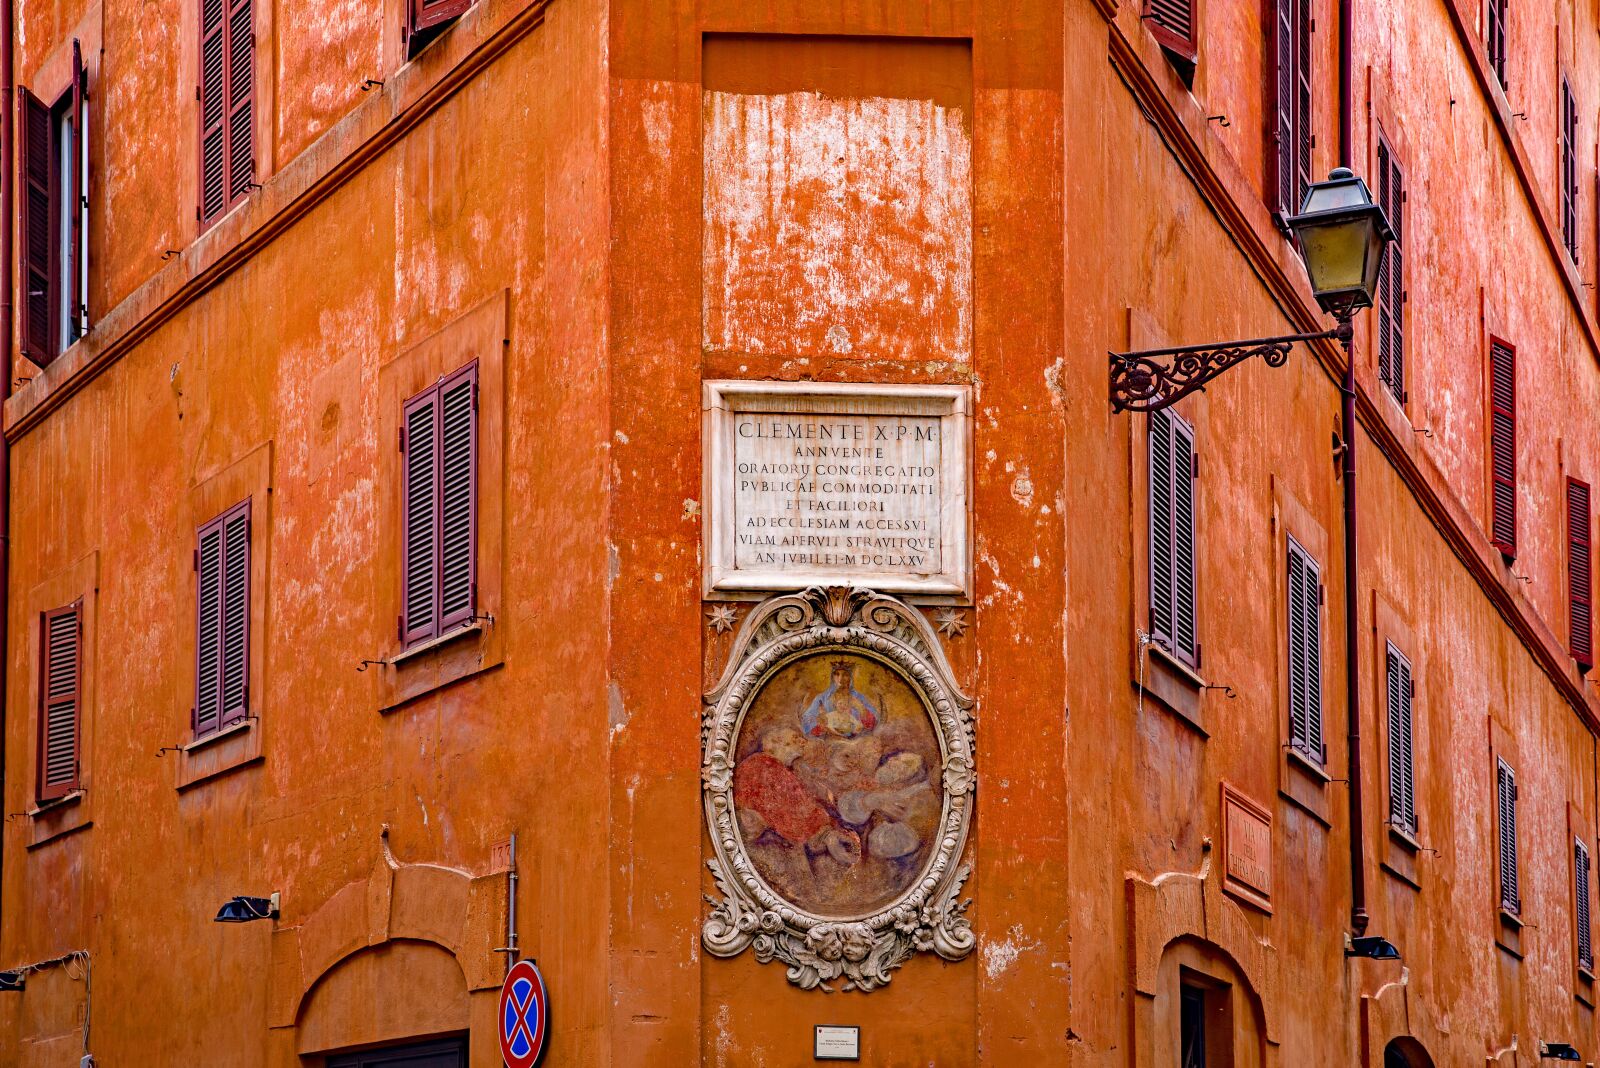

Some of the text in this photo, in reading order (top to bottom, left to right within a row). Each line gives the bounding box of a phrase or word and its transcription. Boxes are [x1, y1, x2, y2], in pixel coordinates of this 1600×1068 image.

[738, 422, 864, 440] CLEMENTE
[795, 446, 884, 459] ANNVENTE
[815, 464, 935, 478] CONGREGATIO
[741, 480, 933, 495] PVBLICAE COMMODITATI
[786, 499, 885, 512] ET FACILIORI
[770, 517, 850, 529] ECCLESIAM
[856, 519, 926, 531] ACCESSVI
[739, 534, 936, 553] VIAM APERVIT STRAVITQVE
[1243, 819, 1256, 844] VIA
